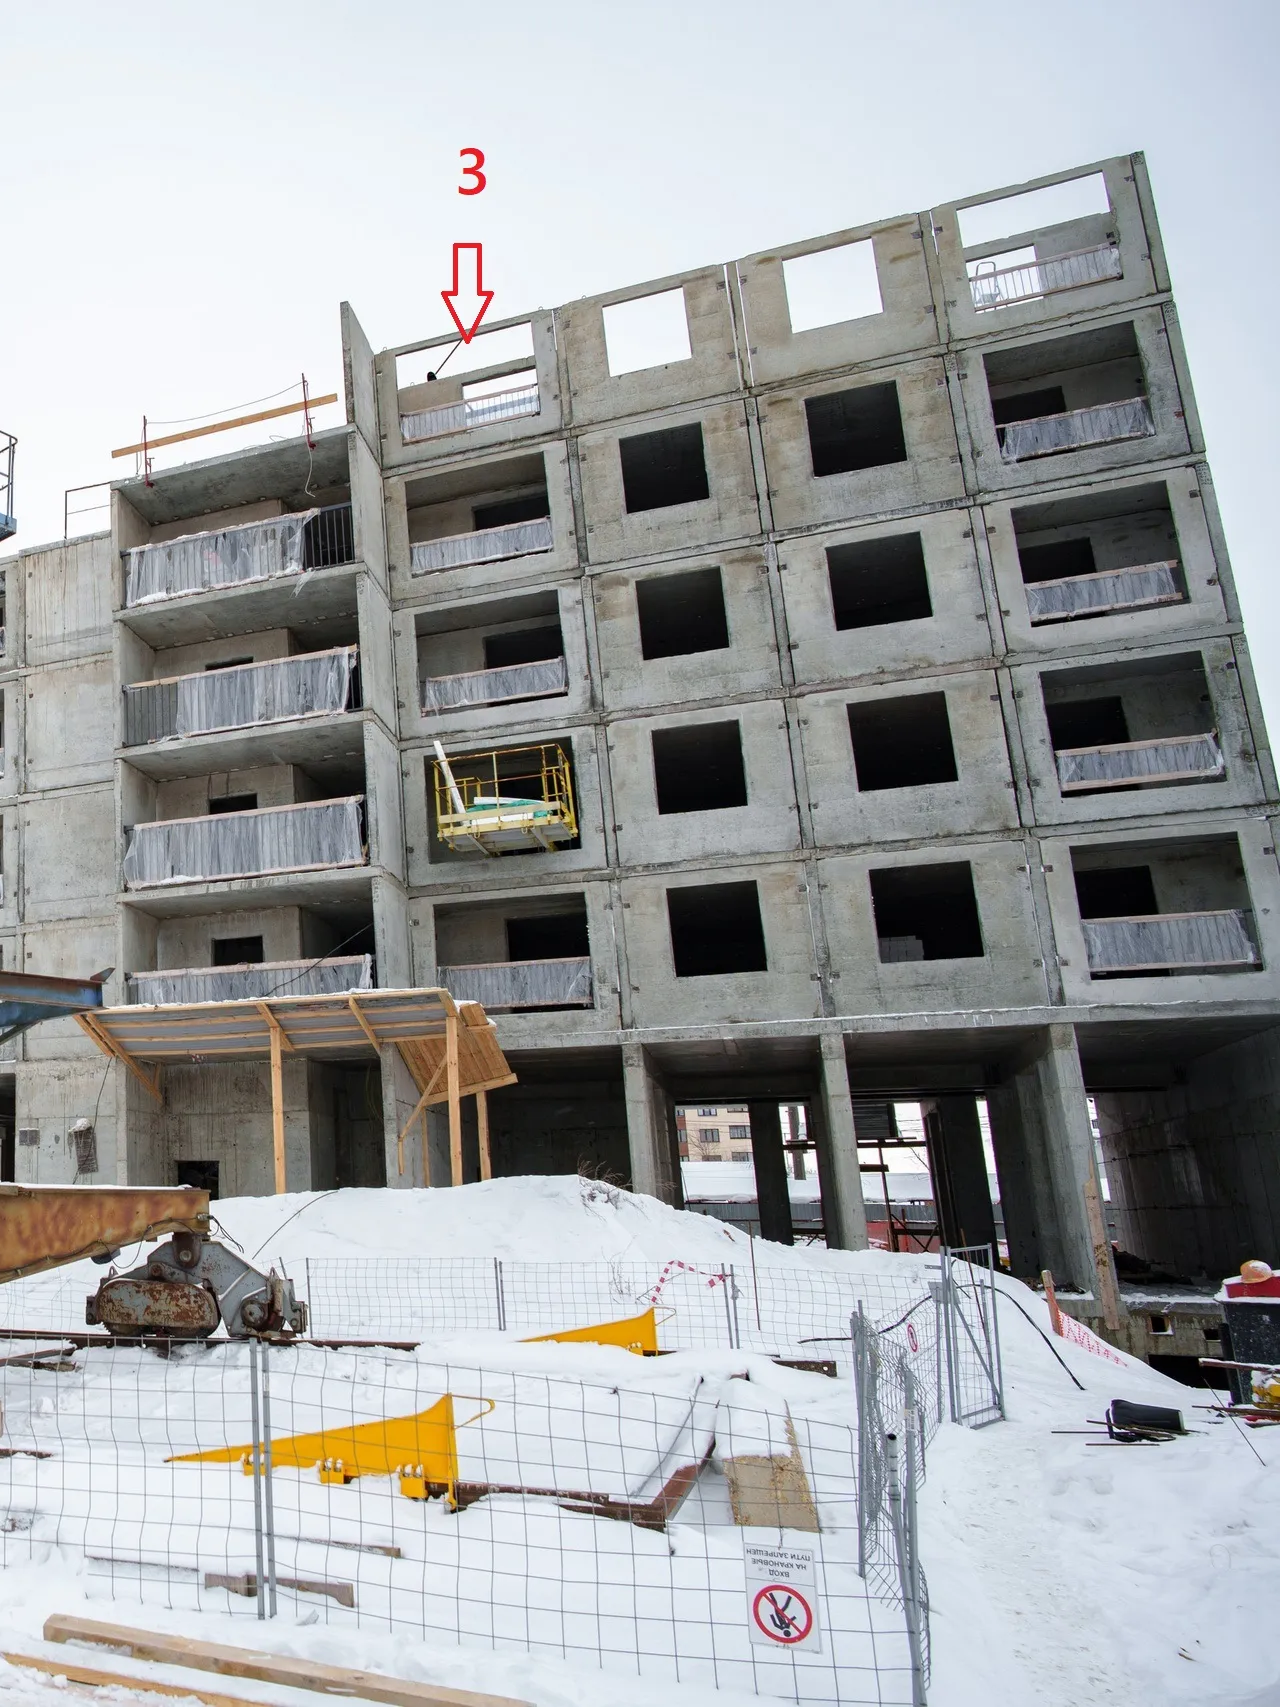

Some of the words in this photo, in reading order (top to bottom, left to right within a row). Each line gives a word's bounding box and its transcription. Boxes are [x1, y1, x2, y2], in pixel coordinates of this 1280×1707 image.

[746, 1548, 789, 1559] ЗАПРЕЩЕН
[790, 1553, 811, 1562] ПУТИ
[751, 1557, 794, 1569] КРАНОВЫЕ
[768, 1568, 790, 1578] ВХОД
